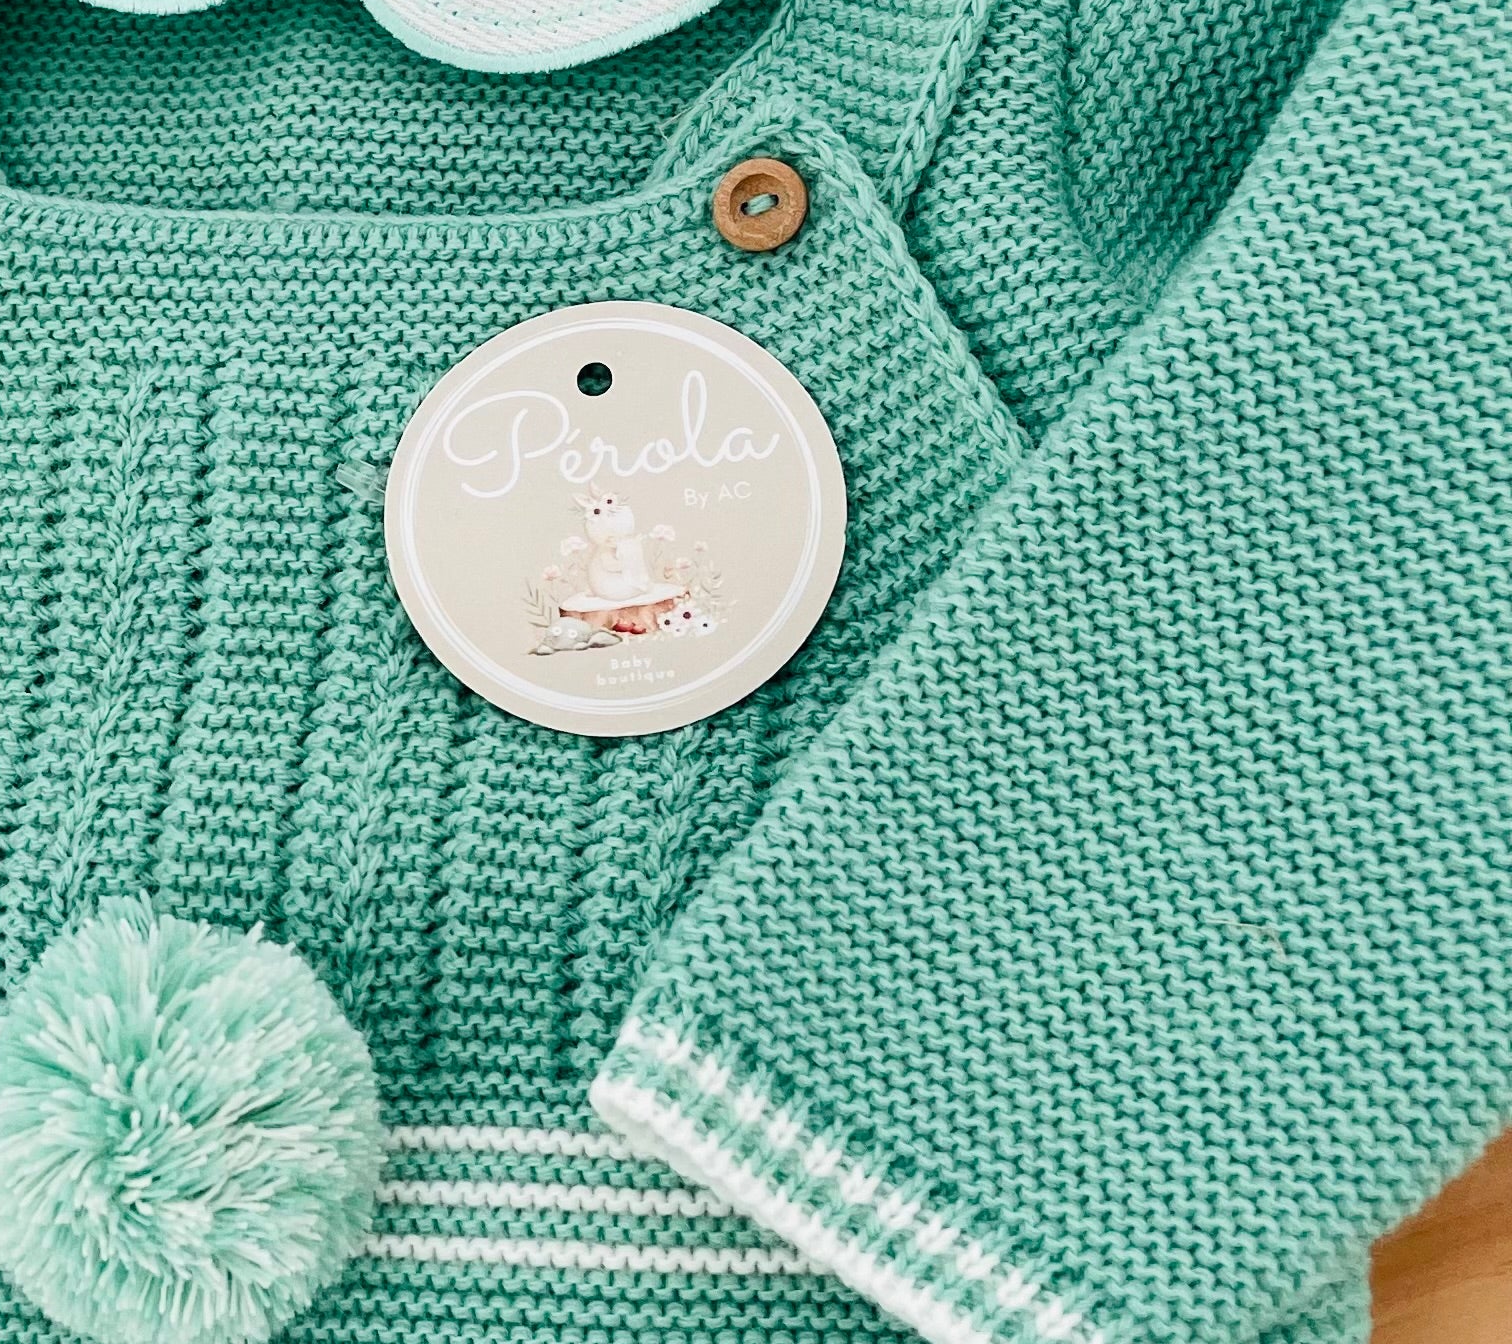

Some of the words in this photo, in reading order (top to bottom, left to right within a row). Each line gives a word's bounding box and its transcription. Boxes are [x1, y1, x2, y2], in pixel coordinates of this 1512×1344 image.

[442, 369, 780, 499] Pérola
[683, 487, 711, 511] By
[717, 480, 753, 505] AC
[595, 669, 676, 687] boutique
